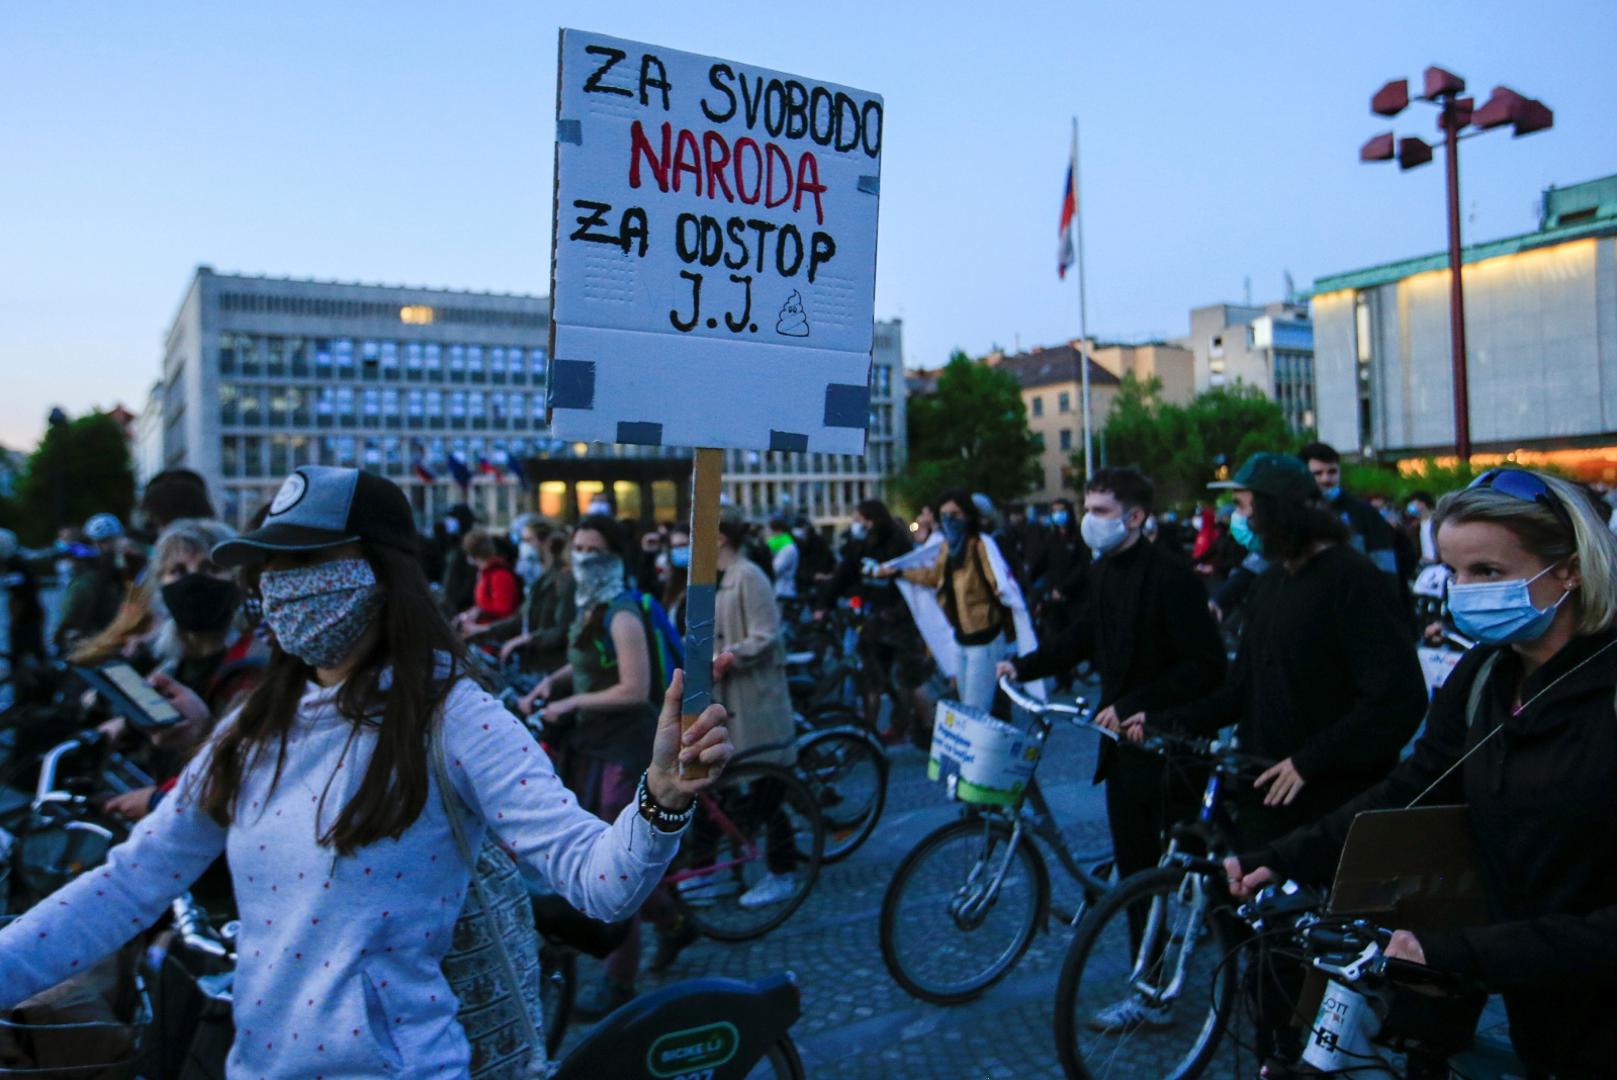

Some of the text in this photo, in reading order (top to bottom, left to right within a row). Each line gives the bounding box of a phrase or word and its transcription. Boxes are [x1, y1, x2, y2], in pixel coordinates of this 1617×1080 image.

[583, 45, 883, 158] ZA SVOBODO
[629, 120, 828, 225] NARODA
[570, 200, 836, 283] ZA ODSTOP
[670, 270, 759, 333] J.J.
